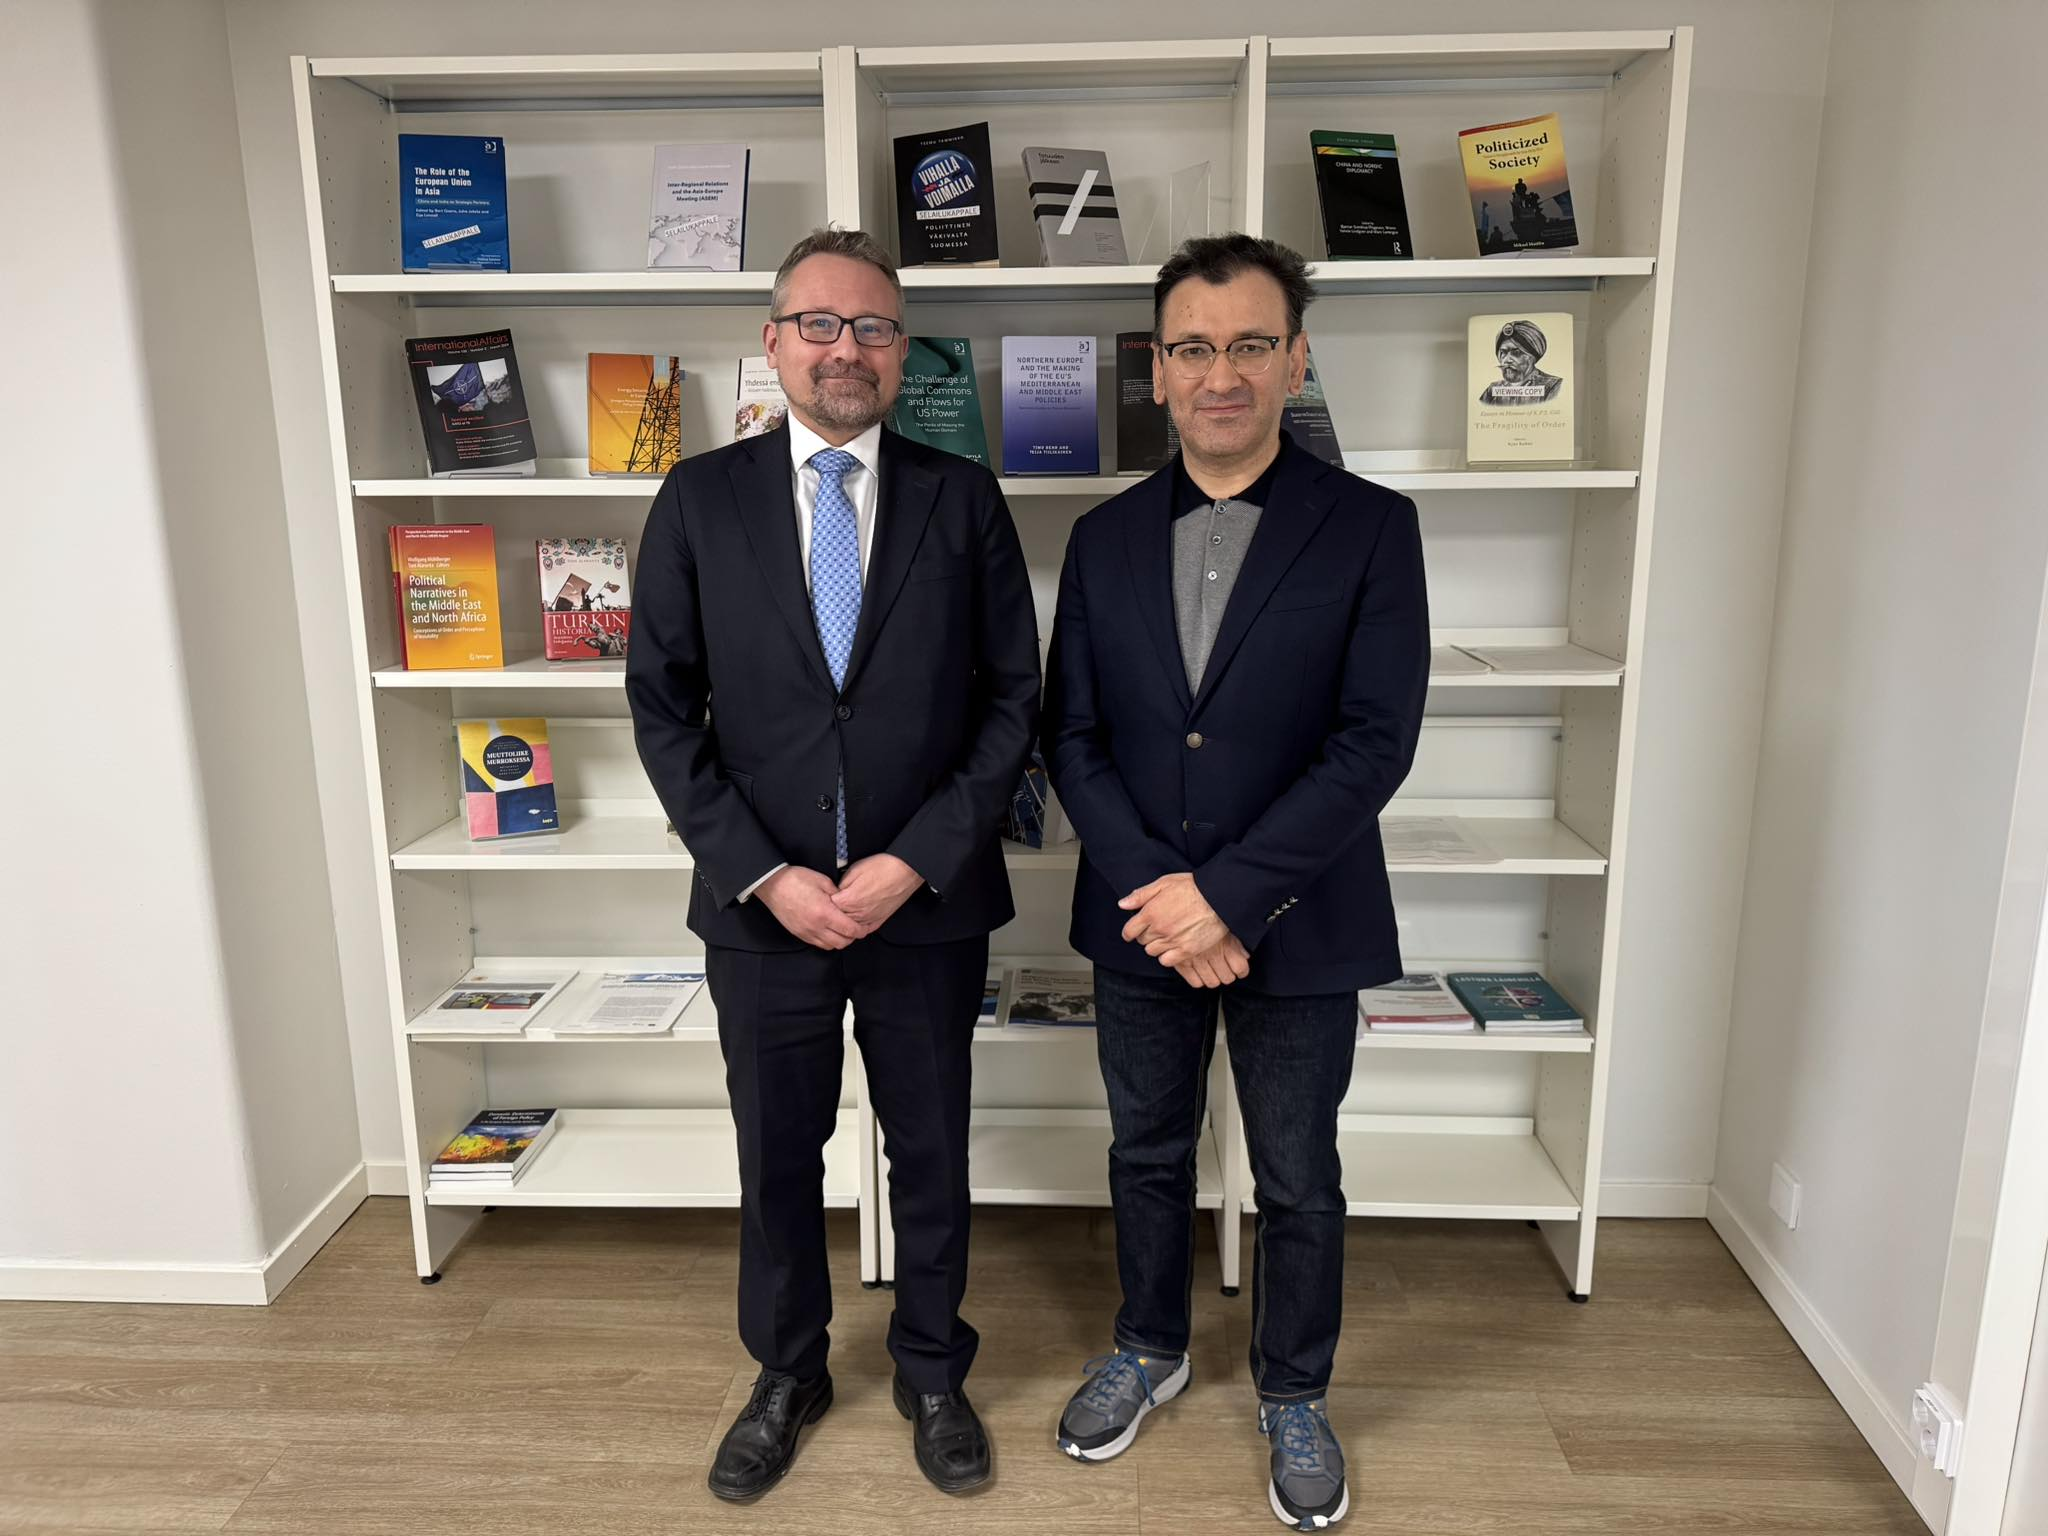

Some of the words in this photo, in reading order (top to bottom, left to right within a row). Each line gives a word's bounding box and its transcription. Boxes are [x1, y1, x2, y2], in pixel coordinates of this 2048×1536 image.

[1475, 132, 1549, 154] Politicized
[1489, 155, 1540, 170] Society
[415, 167, 428, 175] The
[430, 167, 446, 176] Role
[448, 168, 456, 176] of
[458, 168, 470, 176] the
[918, 156, 960, 186] VIHALLA
[415, 177, 449, 187] European
[451, 178, 472, 187] Union
[938, 177, 951, 187] JA
[425, 187, 440, 195] Asia
[924, 174, 975, 208] VOIMALLA
[919, 207, 977, 219] SELAILUKAPPALE
[665, 216, 718, 237] SELAILUKAPPALE
[925, 222, 971, 231] POLIITTINEN
[424, 226, 479, 247] SELAILUKAPPALE
[745, 379, 768, 387] Yhdessä
[914, 374, 959, 386] Challenge
[960, 375, 969, 384] of
[926, 386, 972, 395] Commons
[1494, 388, 1523, 396] VIEWING
[907, 397, 924, 406] and
[925, 397, 952, 406] Flows
[953, 397, 966, 406] for
[916, 408, 931, 417] US
[932, 408, 960, 418] Power
[1475, 422, 1490, 430] The
[1492, 422, 1528, 431] Fragility
[1530, 421, 1539, 429] of
[409, 575, 446, 586] Political
[410, 588, 457, 598] Narratives
[458, 587, 468, 597] in
[411, 600, 427, 611] the
[429, 599, 460, 610] Middle
[463, 599, 481, 609] East
[412, 613, 430, 623] and
[432, 612, 458, 623] North
[461, 611, 487, 622] Africa
[547, 613, 626, 628] TURKIN
[552, 627, 593, 635] HISTORIA
[486, 750, 529, 759] MUUTTOLIIKE
[486, 757, 531, 765] MURROKSESSA
